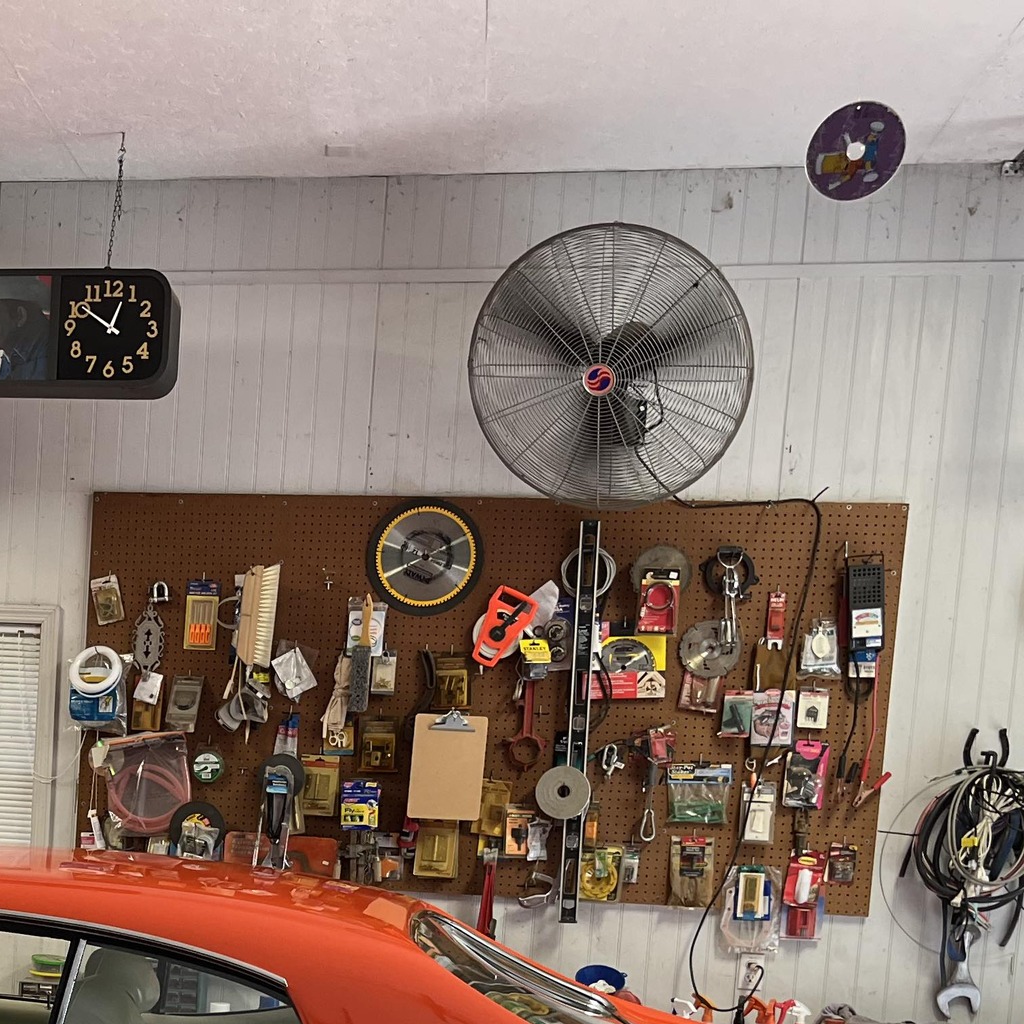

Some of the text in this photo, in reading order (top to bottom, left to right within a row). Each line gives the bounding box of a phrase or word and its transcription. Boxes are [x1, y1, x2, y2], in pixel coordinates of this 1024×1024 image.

[84, 285, 102, 302] 11
[103, 280, 124, 297] 12
[128, 285, 137, 302] 1
[68, 301, 91, 319] 10
[139, 300, 152, 318] 2
[64, 319, 77, 337] 9
[146, 320, 158, 338] 3
[70, 340, 82, 358] 8
[136, 342, 149, 359] 4
[85, 355, 97, 373] 7
[102, 360, 115, 378] 6
[121, 356, 134, 374] 5
